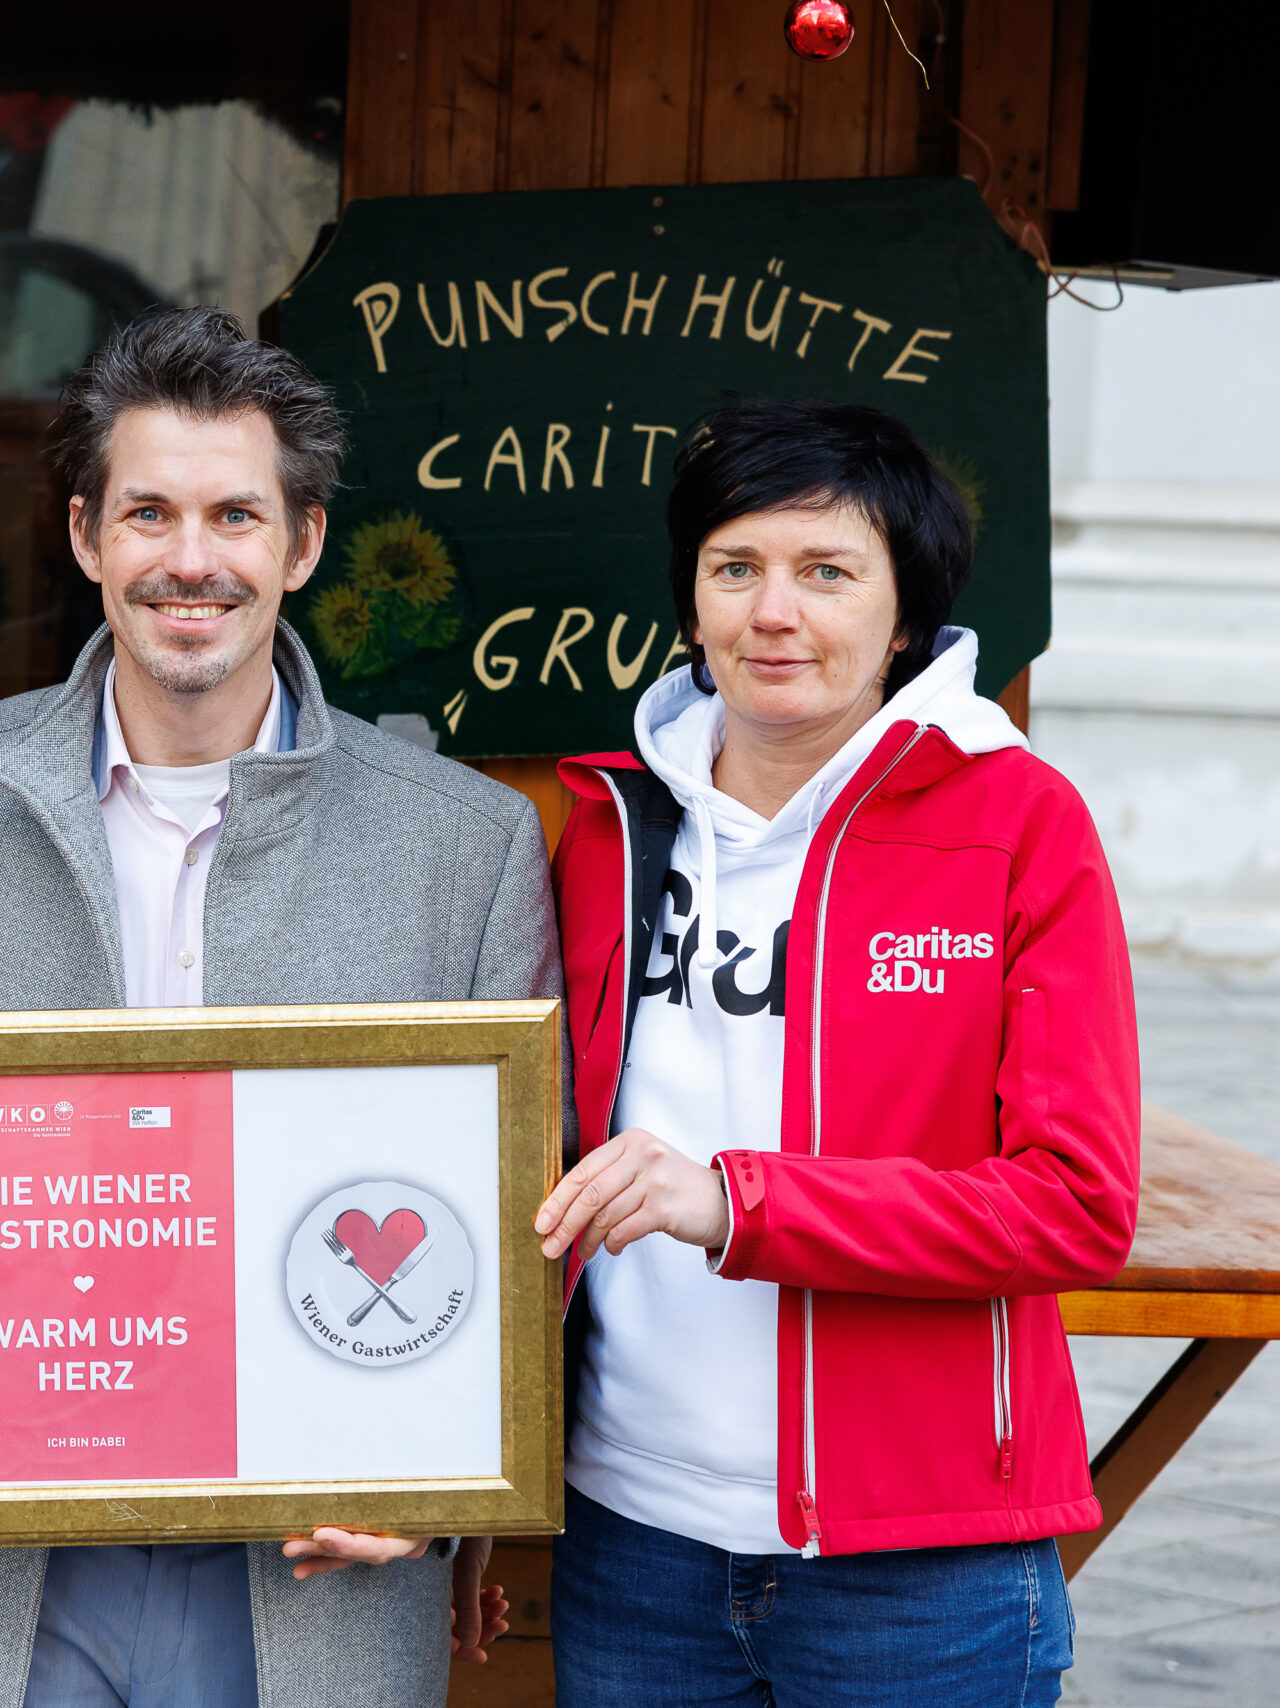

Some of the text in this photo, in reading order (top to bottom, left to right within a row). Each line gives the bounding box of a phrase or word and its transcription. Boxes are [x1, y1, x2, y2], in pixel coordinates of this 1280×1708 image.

[868, 926, 994, 961] Caritas
[866, 960, 945, 994] &Du
[43, 1174, 192, 1205] WIENER
[109, 1316, 189, 1346] UMS
[300, 1288, 464, 1358] Wiener Gastwirtschaft
[38, 1361, 134, 1391] HERZ
[47, 1436, 126, 1448] ICH BIN DABEI
